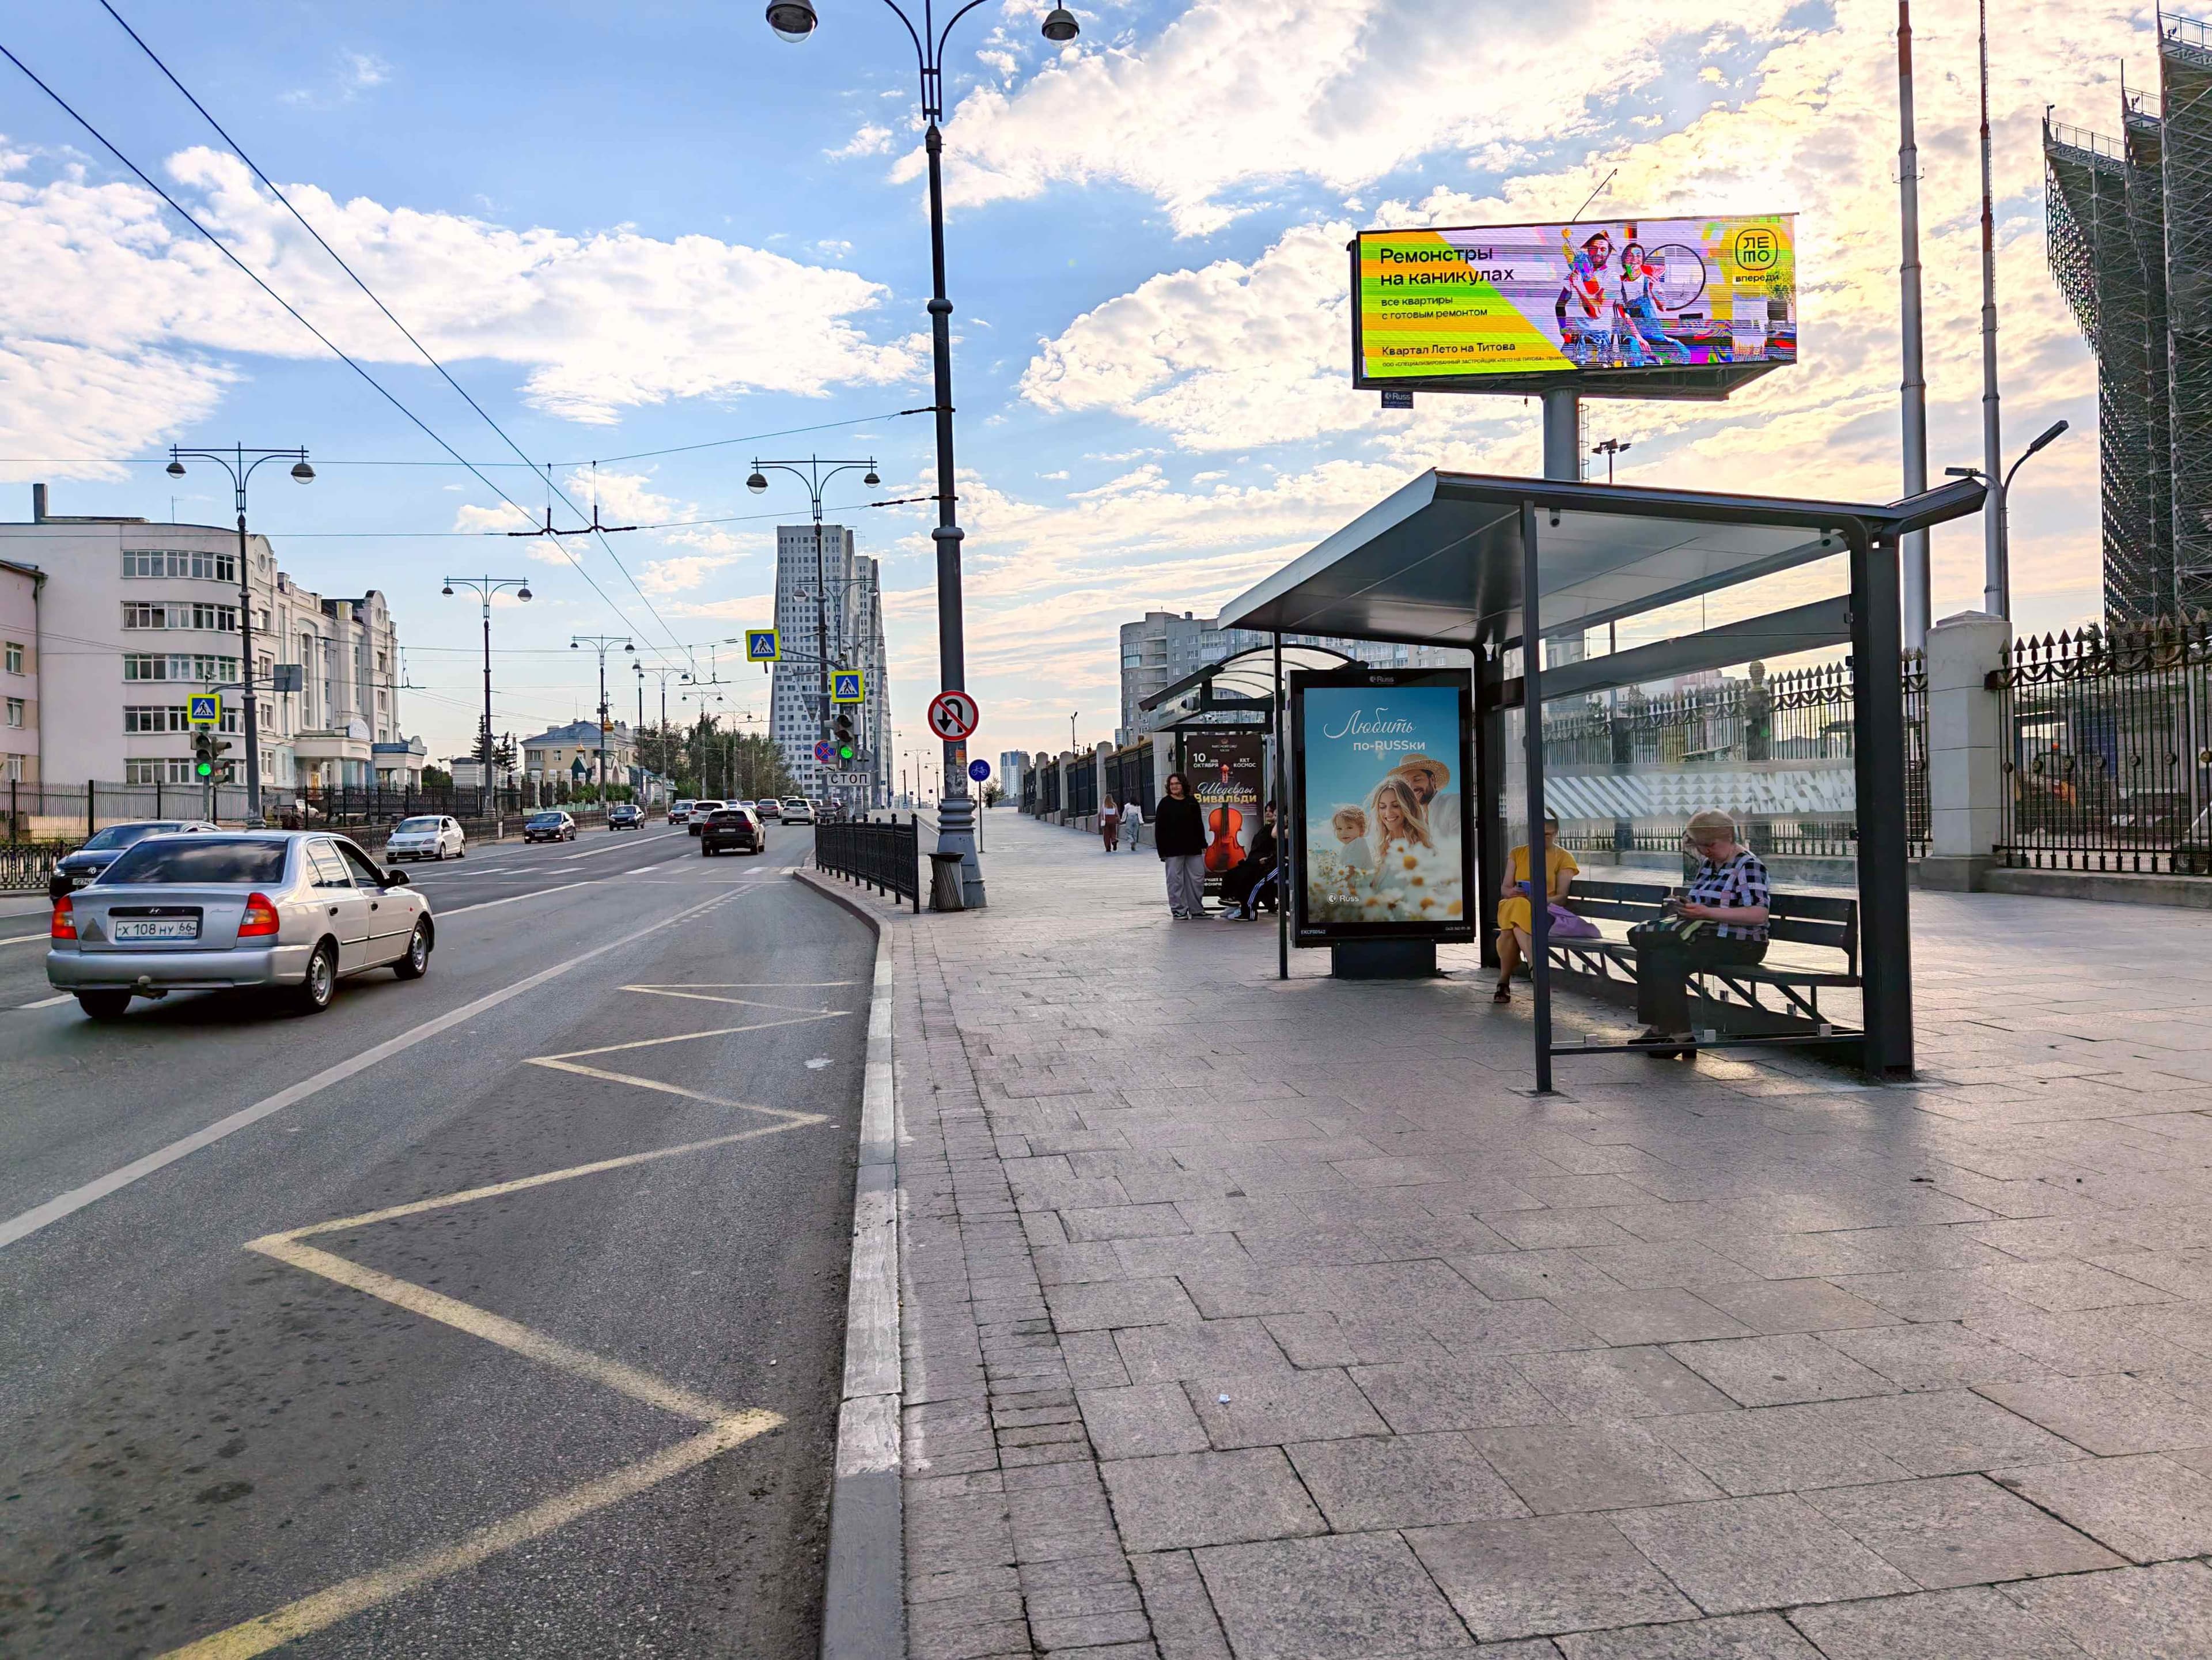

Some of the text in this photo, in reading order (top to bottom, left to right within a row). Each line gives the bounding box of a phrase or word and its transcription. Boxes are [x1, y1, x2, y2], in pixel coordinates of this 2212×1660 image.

[1381, 248, 1493, 264] Ремонстры
[1381, 269, 1514, 286] на каникулах
[1735, 274, 1779, 283] впереди
[1381, 297, 1453, 307] все квартиры
[1390, 310, 1434, 319] готовым
[1435, 308, 1488, 319] ремонтом
[1382, 346, 1429, 357] Квартал
[1431, 345, 1458, 354] Лето
[1476, 342, 1516, 352] Титова
[1323, 708, 1416, 739] Любить
[1353, 740, 1426, 751] по-RUSSки
[1193, 753, 1206, 762] 10
[831, 774, 867, 784] СТОП
[1198, 782, 1255, 795] Шедевры
[1194, 793, 1257, 803] Вивальди
[133, 924, 156, 936] 108
[179, 922, 192, 932] 66
